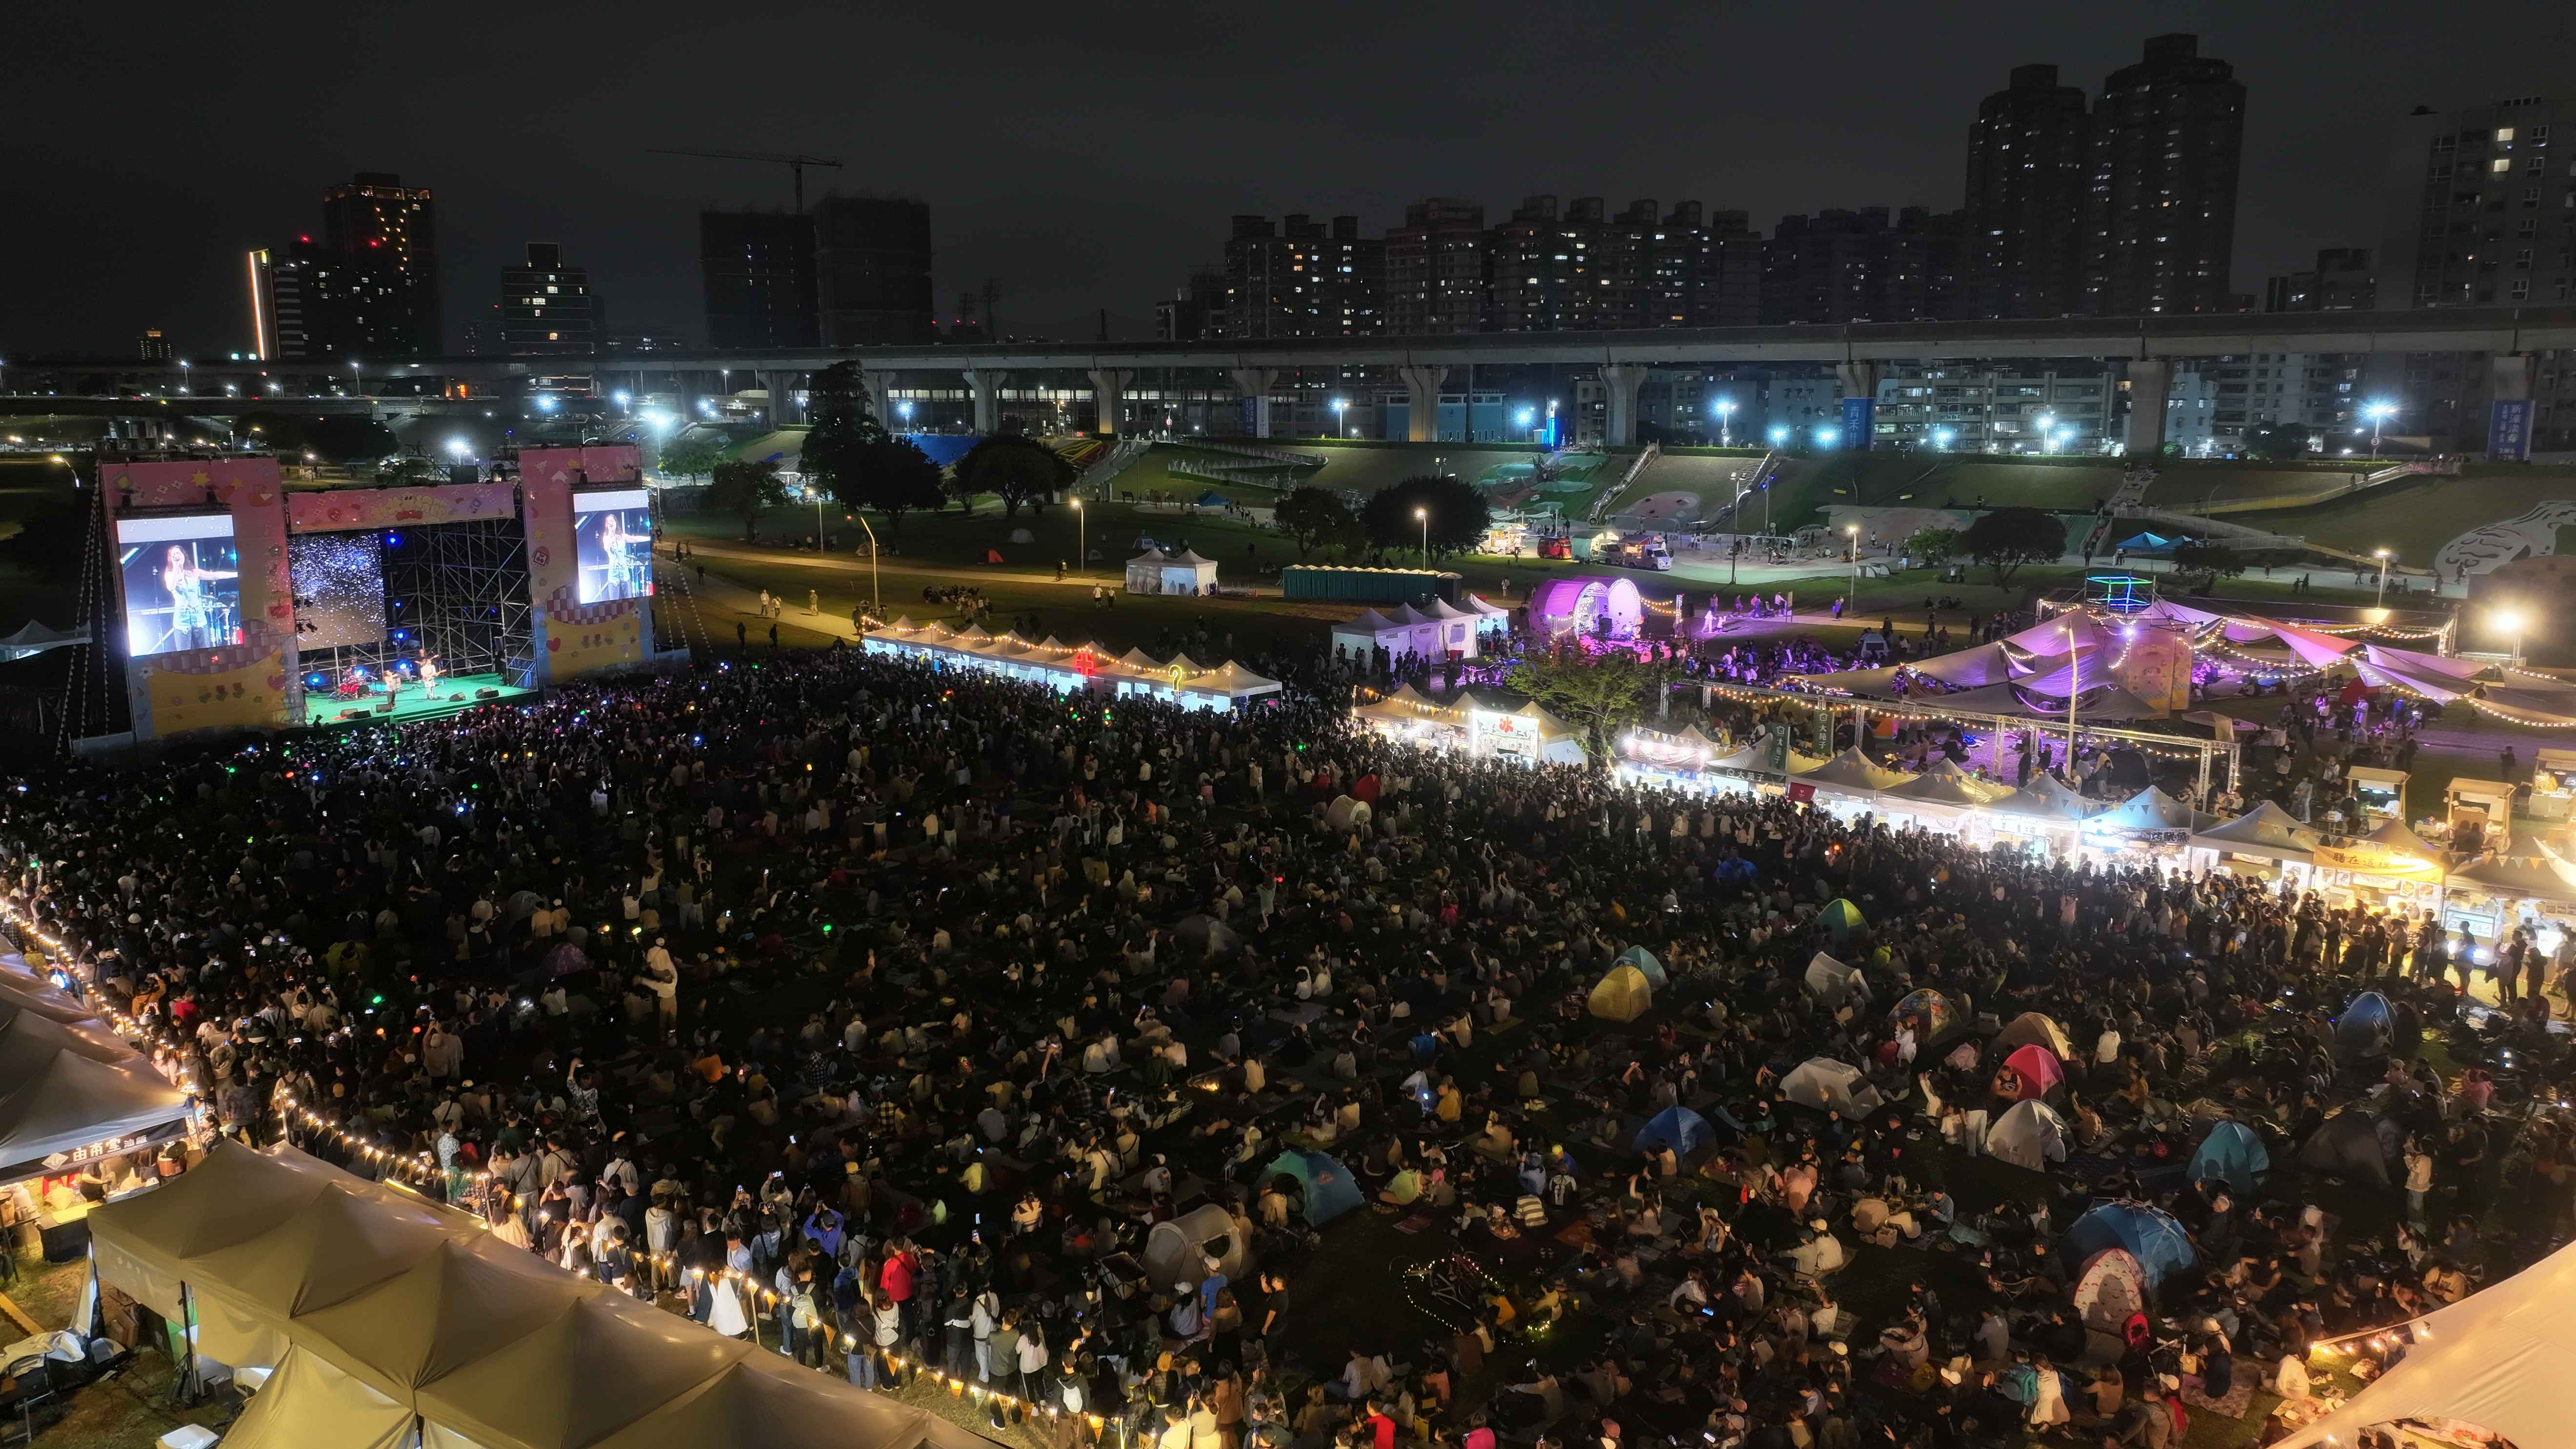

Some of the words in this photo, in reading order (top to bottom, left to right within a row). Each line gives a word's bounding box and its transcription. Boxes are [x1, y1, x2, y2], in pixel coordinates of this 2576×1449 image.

[1849, 406, 1859, 430] 青禾
[1499, 716, 1514, 733] 冰
[1819, 725, 1827, 749] 大苑子
[1738, 771, 1765, 782] 大苑子
[2150, 831, 2188, 844] 烤魷魚
[2333, 852, 2391, 869] 腸在這裡
[123, 1135, 148, 1148] 油飯
